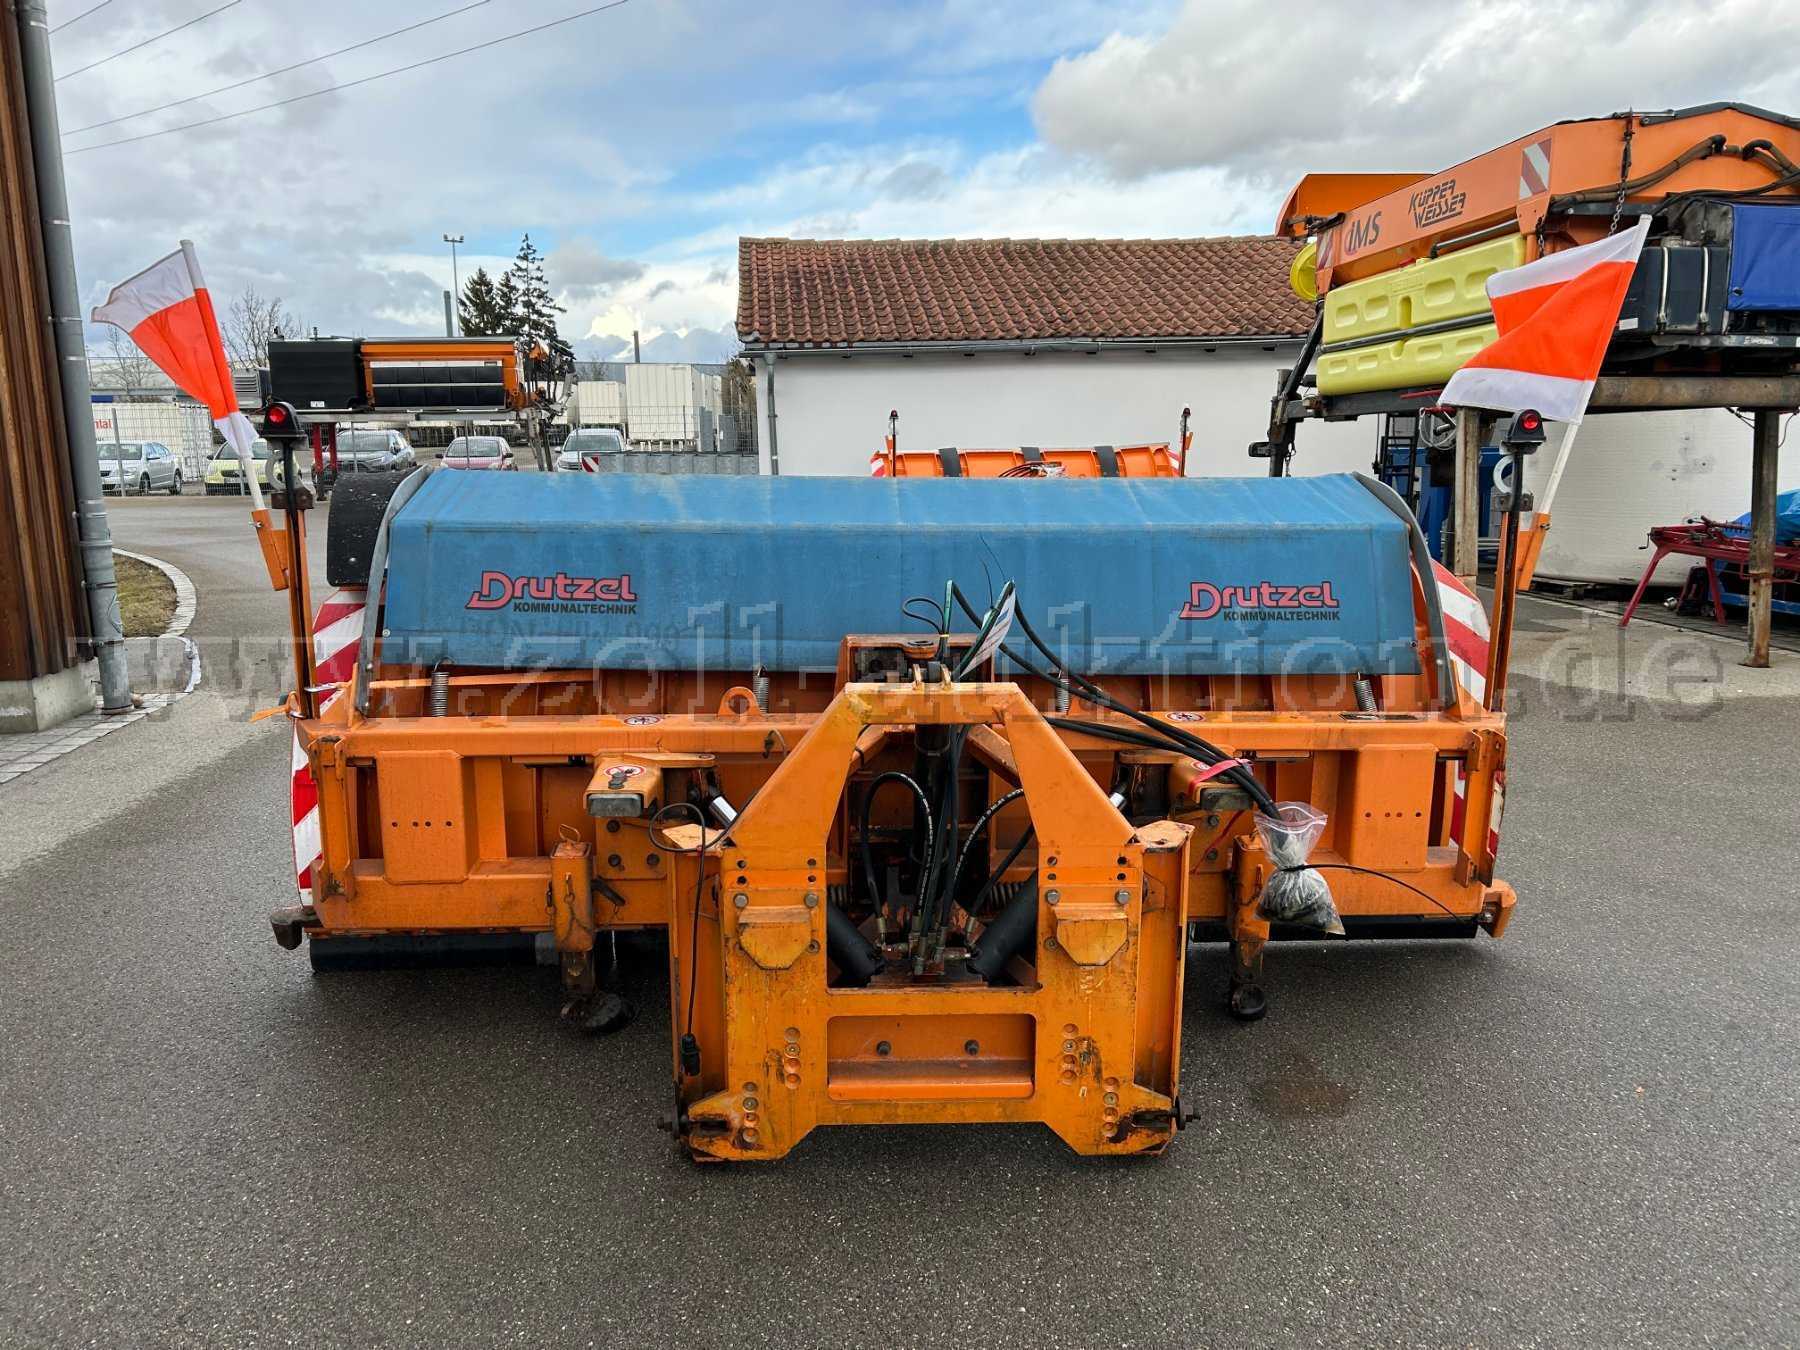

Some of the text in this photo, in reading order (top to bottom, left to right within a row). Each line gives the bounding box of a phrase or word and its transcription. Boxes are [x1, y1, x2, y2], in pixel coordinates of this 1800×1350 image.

[1413, 191, 1467, 229] WEISSER
[464, 570, 637, 610] Drutzel
[513, 602, 637, 615] KOMMUNALTECHNIK
[1178, 580, 1340, 620] Drutzel
[1223, 610, 1340, 621] KOMMUNALTECHNIK
